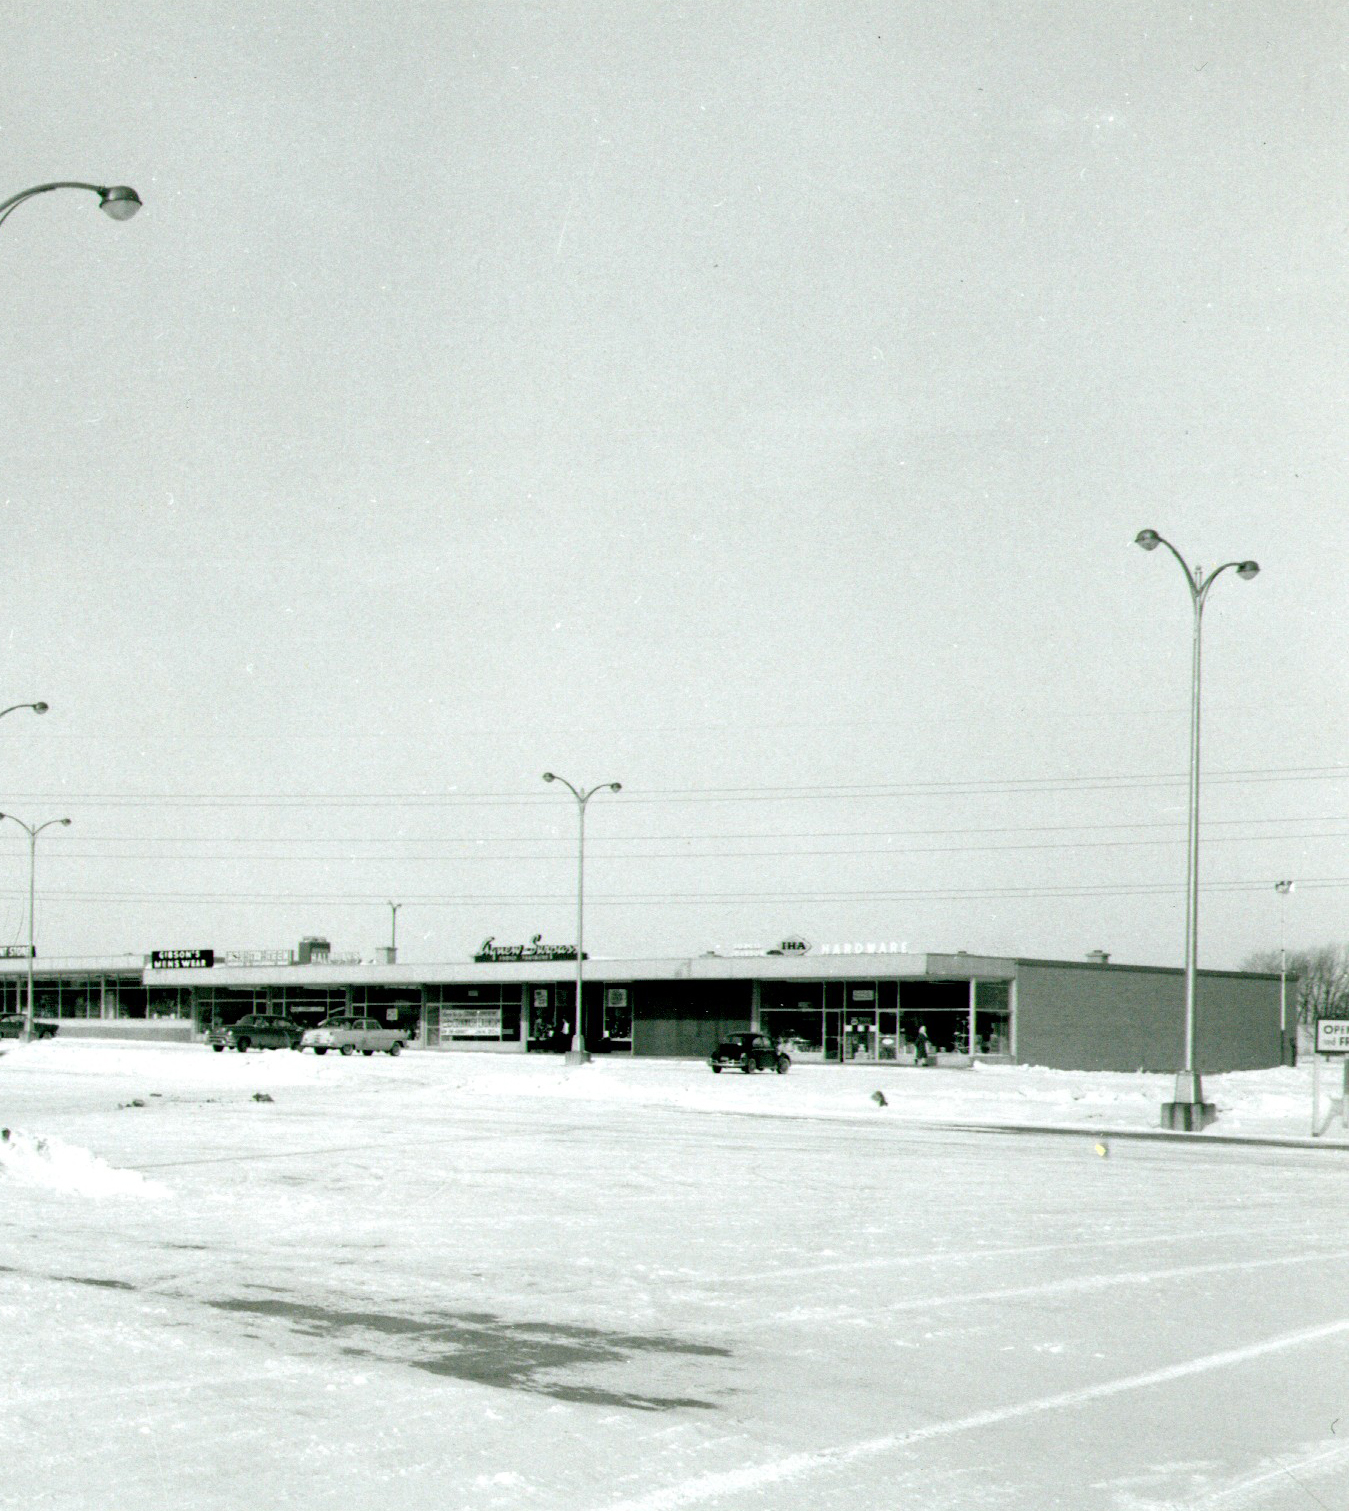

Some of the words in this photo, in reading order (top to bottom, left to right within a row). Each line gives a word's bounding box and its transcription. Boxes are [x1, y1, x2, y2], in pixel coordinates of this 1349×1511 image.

[782, 942, 806, 950] IHA
[821, 942, 908, 954] HARDWARE
[158, 951, 200, 959] GIBSON'S
[181, 959, 206, 967] WEAR
